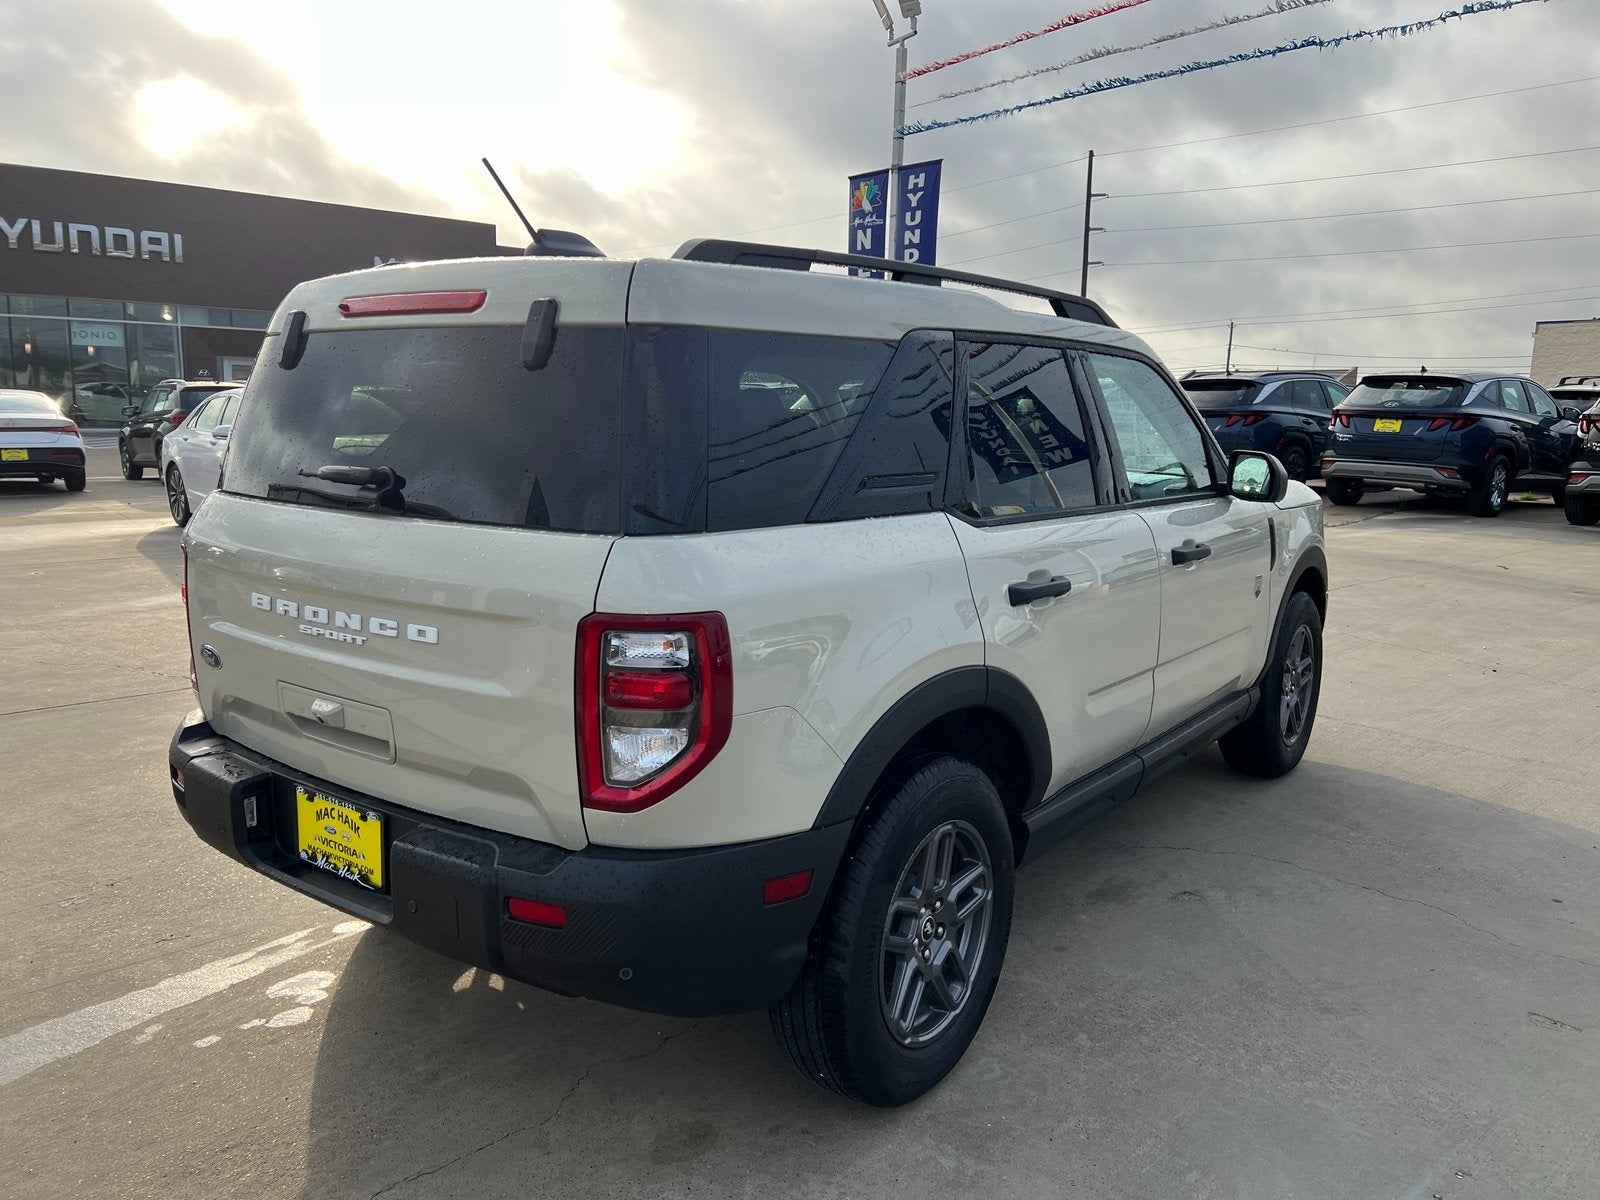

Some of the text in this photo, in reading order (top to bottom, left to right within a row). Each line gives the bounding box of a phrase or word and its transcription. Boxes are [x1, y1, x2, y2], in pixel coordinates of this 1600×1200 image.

[0, 217, 184, 263] YUNDAI
[251, 592, 439, 644] BRONCO
[299, 624, 368, 645] SPORT
[316, 807, 361, 839] MAC HAIK
[319, 837, 358, 859] VICTORIA
[316, 856, 338, 873] Mac
